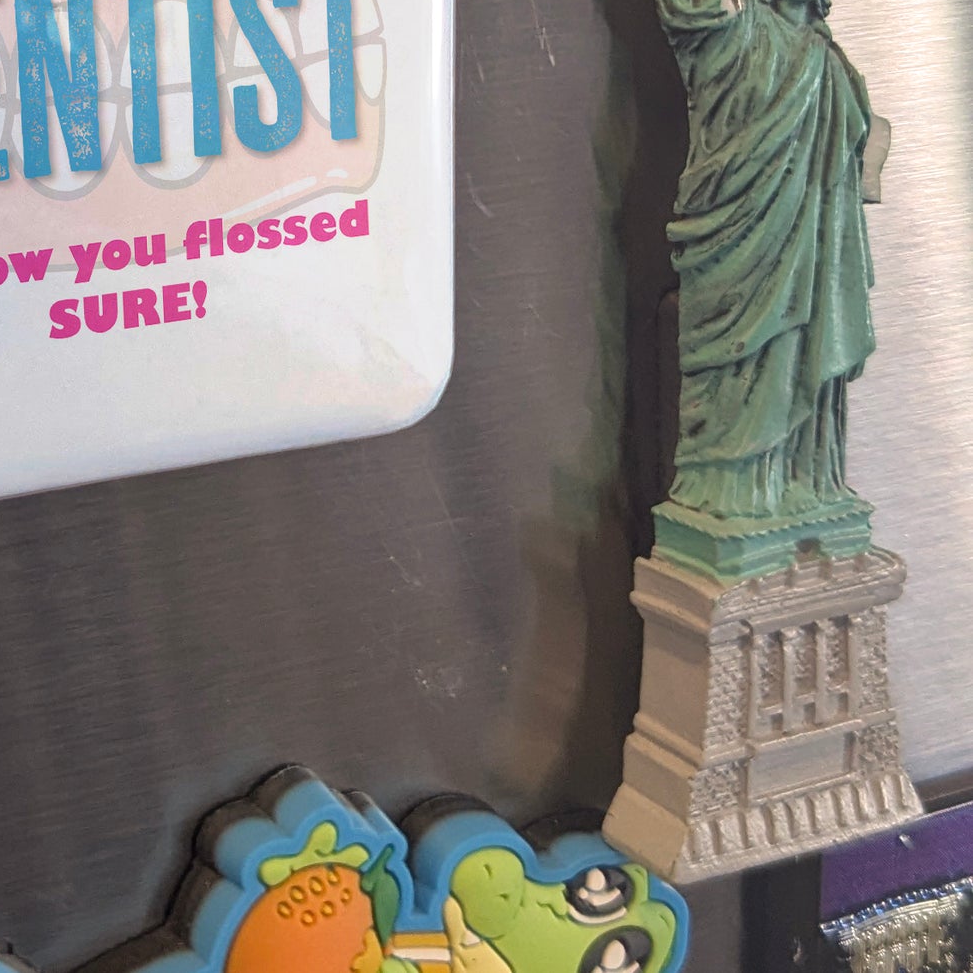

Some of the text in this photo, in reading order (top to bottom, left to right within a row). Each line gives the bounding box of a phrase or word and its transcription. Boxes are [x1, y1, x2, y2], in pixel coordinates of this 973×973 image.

[73, 234, 167, 284] you
[183, 199, 370, 259] flossed
[49, 280, 208, 339] SURE!
